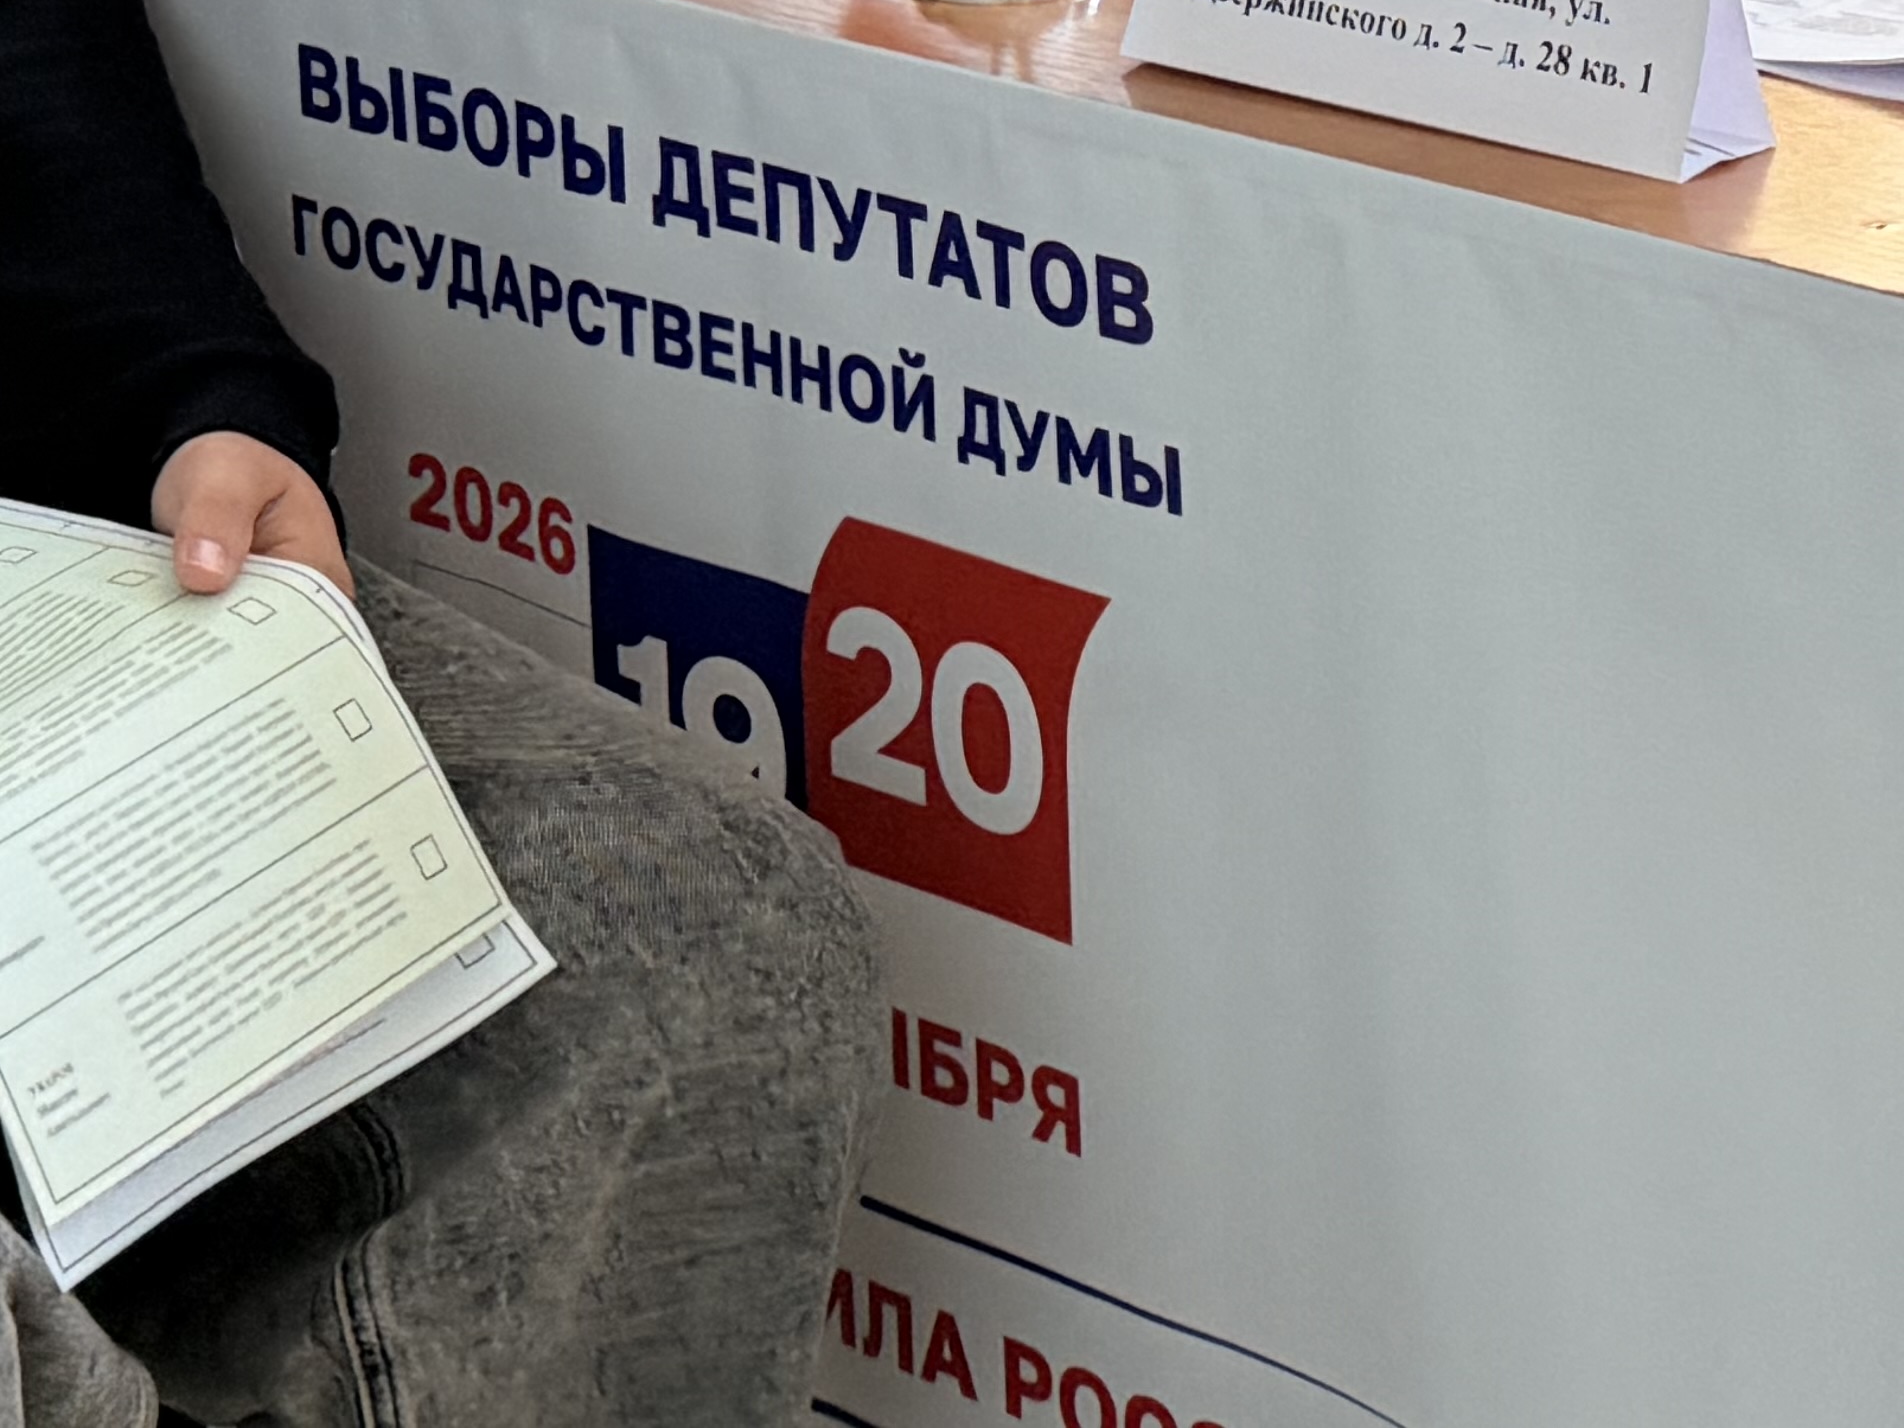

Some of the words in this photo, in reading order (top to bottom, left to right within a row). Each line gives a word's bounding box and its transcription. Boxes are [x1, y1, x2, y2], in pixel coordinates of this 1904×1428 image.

[1412, 22, 1440, 50] д.
[1448, 20, 1469, 55] 2
[1497, 41, 1526, 68] д.
[1535, 40, 1573, 77] 28
[1579, 56, 1626, 90] кв.
[1639, 60, 1654, 95] 1
[298, 42, 627, 205] ВЫБОРЫ
[651, 135, 1155, 345] ДЕПУТАТОВ
[290, 192, 937, 443] ГОСУДАРСТВЕННОЙ
[956, 385, 1184, 517] ДУМЫ
[406, 452, 577, 576] 2026
[825, 605, 1044, 836] 20
